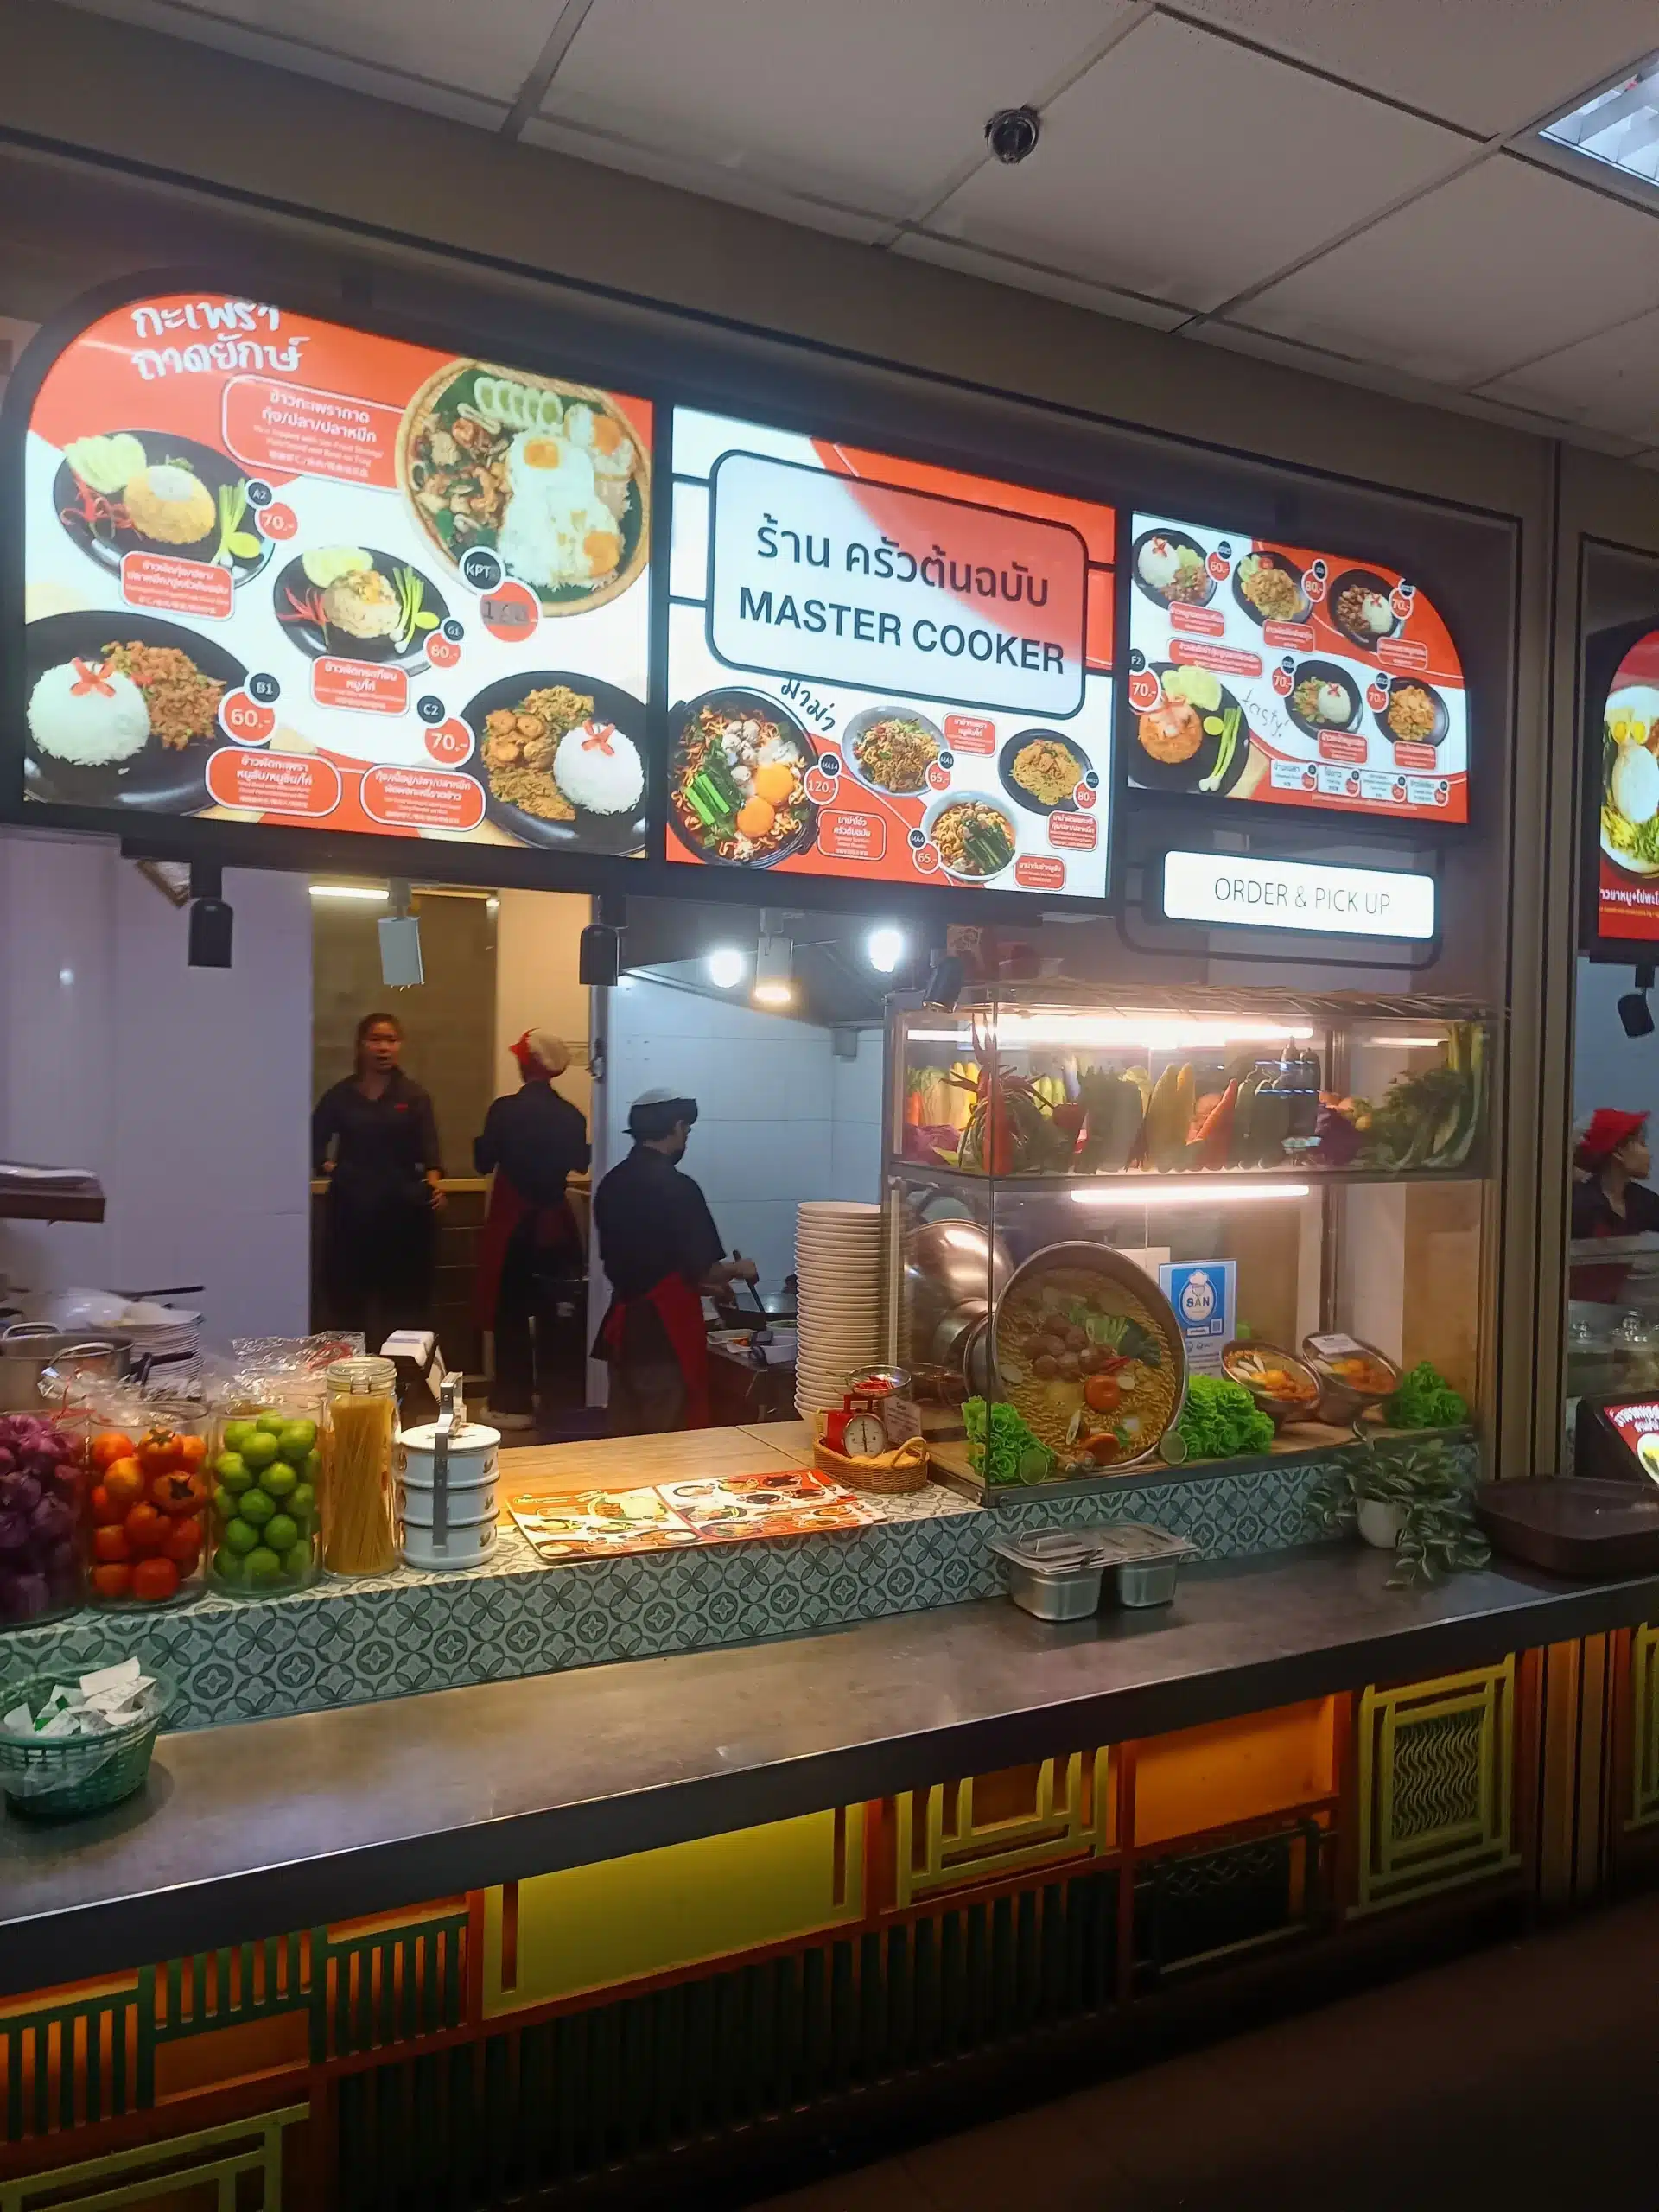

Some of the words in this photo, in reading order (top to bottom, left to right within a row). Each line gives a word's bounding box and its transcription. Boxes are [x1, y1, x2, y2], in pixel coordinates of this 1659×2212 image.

[130, 302, 280, 338] กะเพรา
[130, 332, 311, 380] ถาดยักษ์
[757, 513, 830, 568] ร้าน
[845, 536, 1049, 607] ครัวต้นฉบับ
[467, 563, 491, 579] KPT
[740, 586, 902, 647] MASTER
[912, 619, 1065, 675] COOKER
[1131, 656, 1141, 665] F2
[256, 682, 274, 695] B1
[1132, 683, 1156, 697] 70.-
[423, 704, 439, 716] C2
[781, 679, 836, 732] มาม่า
[231, 708, 271, 729] 60.-
[431, 733, 467, 752] 70.-
[1214, 877, 1287, 906] ORDER
[1294, 885, 1306, 908] &
[1315, 887, 1358, 912] PICK
[1365, 893, 1390, 915] UP
[1186, 1296, 1210, 1308] SAN
